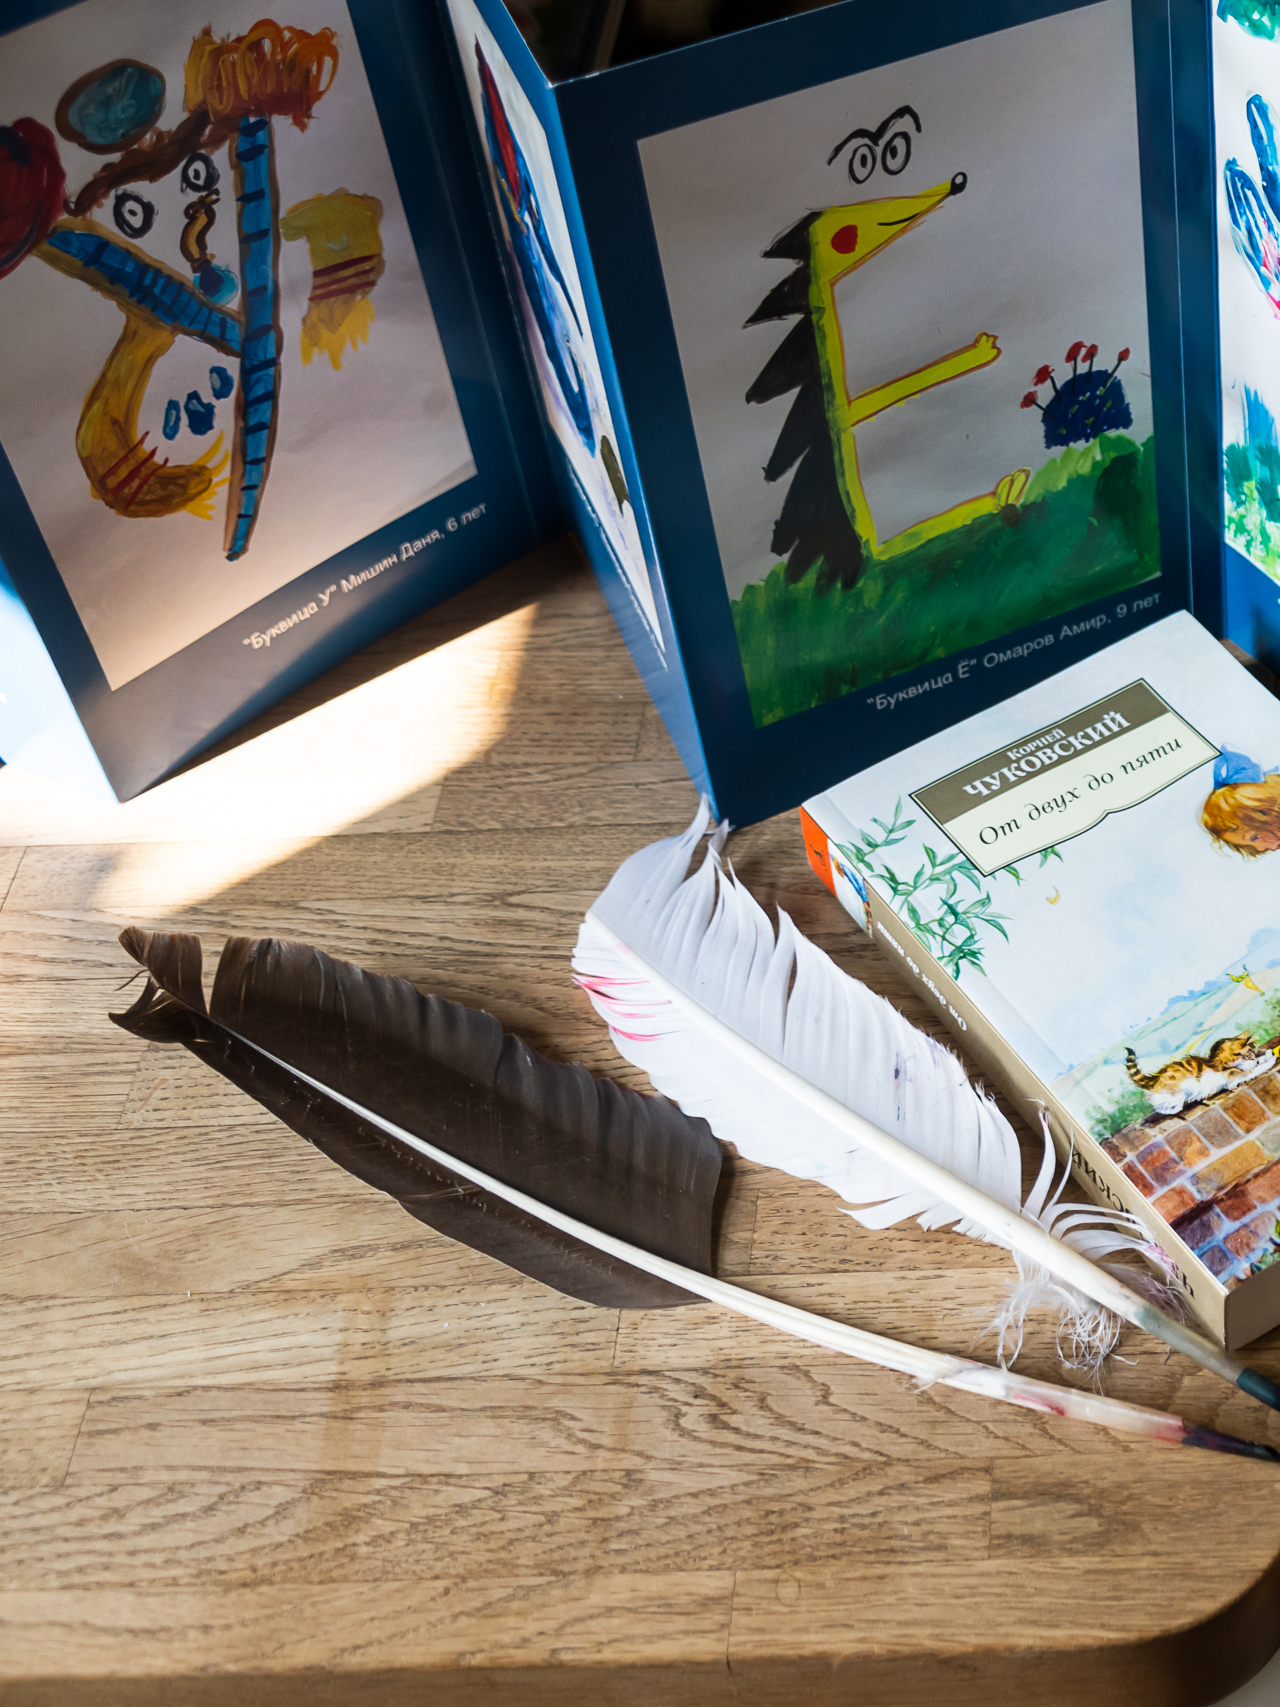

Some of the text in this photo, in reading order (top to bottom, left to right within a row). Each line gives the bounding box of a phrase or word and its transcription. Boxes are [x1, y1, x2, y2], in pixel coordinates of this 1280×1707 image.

[340, 553, 398, 593] Мишин
[400, 529, 445, 561] Даня,
[445, 517, 458, 533] 6
[460, 502, 488, 526] лет
[983, 633, 1055, 669] Омаров
[1058, 613, 1112, 641] Амир,
[1115, 603, 1128, 619] 9
[1131, 591, 1162, 613] лет
[962, 710, 1131, 798] ЧУКОВСКИЙ
[979, 738, 1183, 845] От двух до пяти
